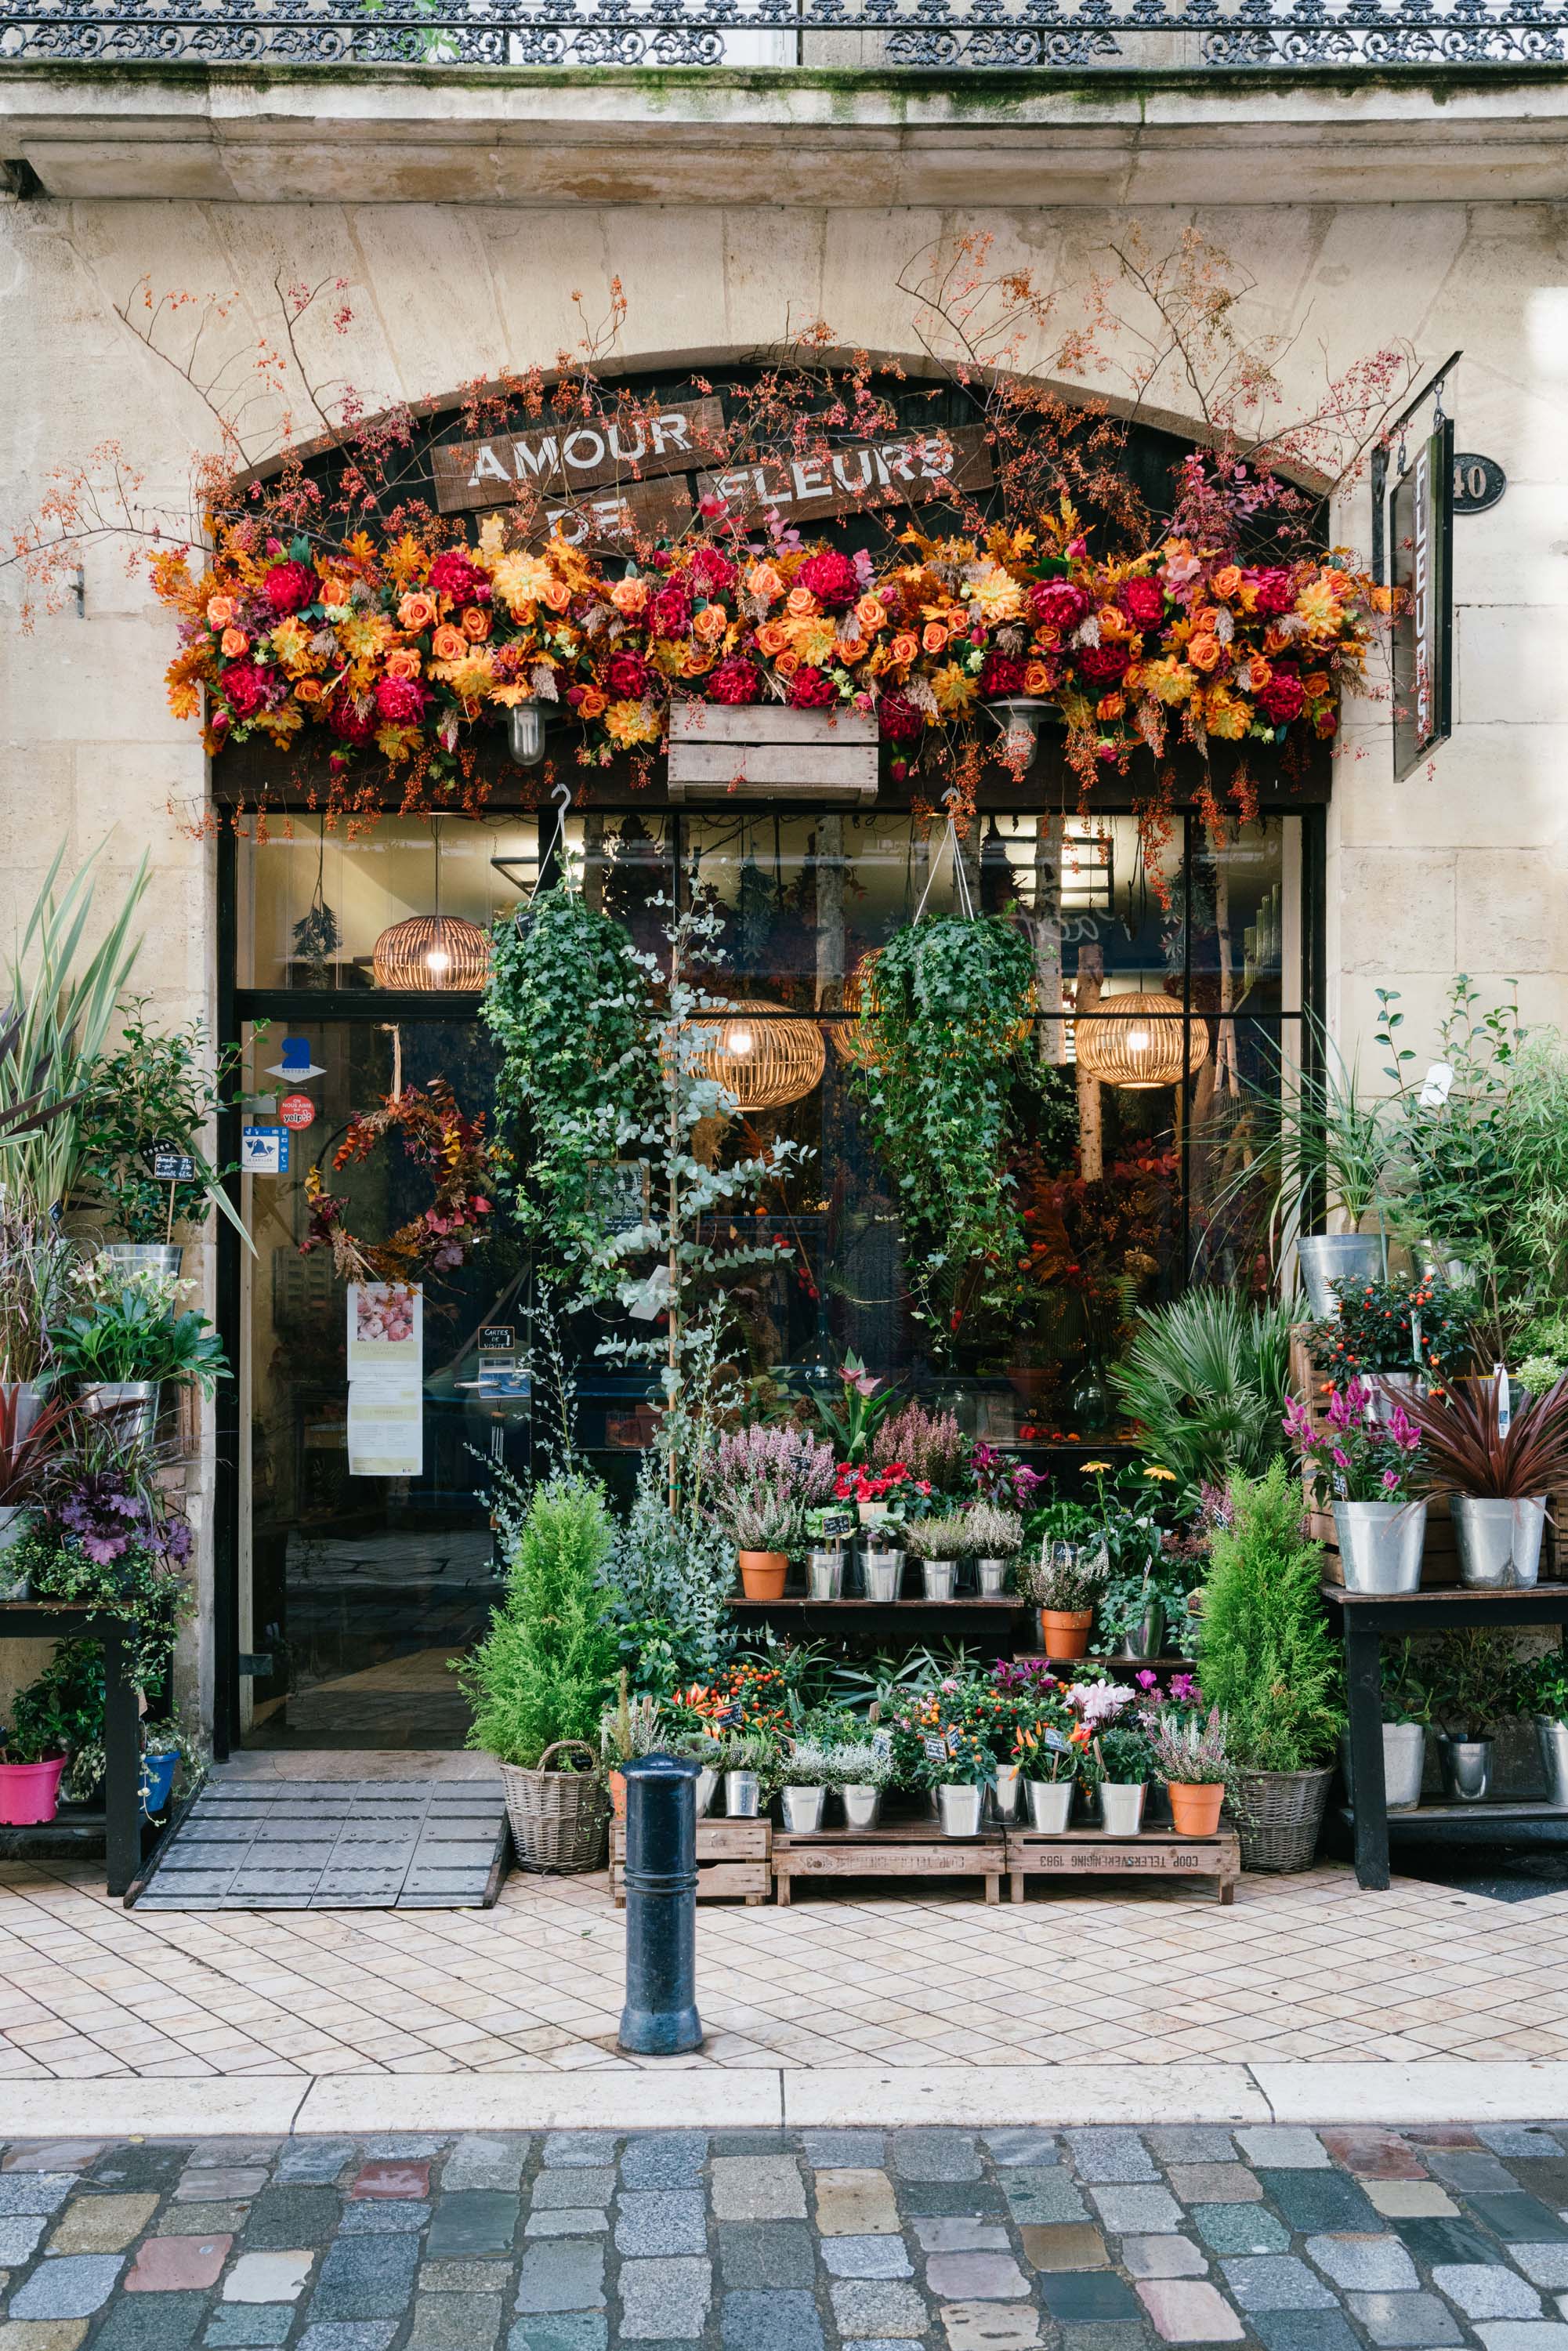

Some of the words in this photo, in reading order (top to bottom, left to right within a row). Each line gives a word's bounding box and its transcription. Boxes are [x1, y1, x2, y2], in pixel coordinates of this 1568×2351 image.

[467, 413, 693, 487] AMOUR
[712, 438, 954, 515] FLEURS
[1454, 465, 1487, 498] 40
[545, 497, 635, 546] DE
[284, 1113, 303, 1123] yelp
[1040, 1855, 1065, 1867] 1983
